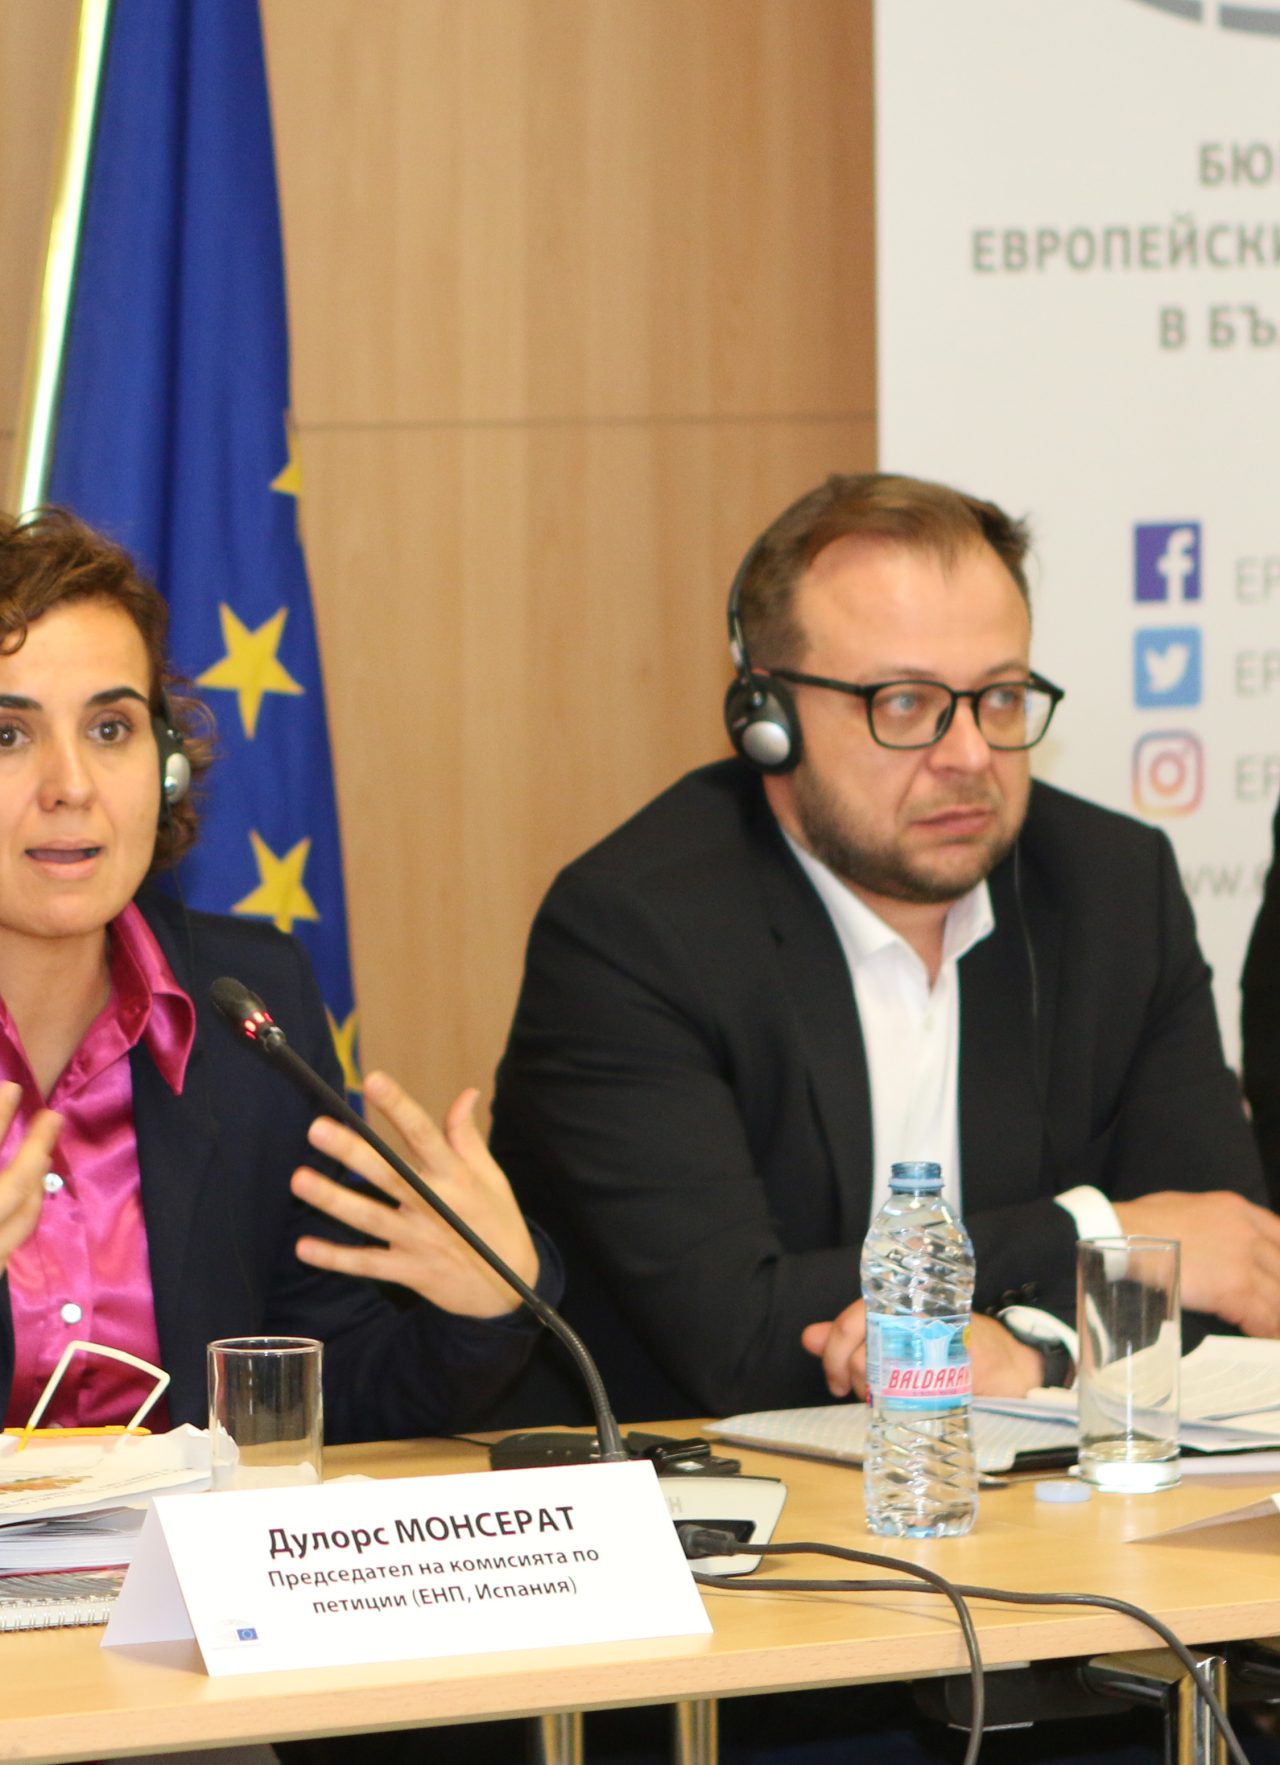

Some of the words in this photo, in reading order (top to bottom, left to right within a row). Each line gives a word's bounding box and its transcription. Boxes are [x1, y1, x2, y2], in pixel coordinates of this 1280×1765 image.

[1199, 141, 1280, 187] БЮ
[1159, 304, 1188, 351] В
[1207, 303, 1280, 350] БЪ
[1234, 556, 1280, 602] EP
[1234, 651, 1280, 697] EP
[269, 1528, 390, 1559] Дулорс
[394, 1506, 574, 1543] МОНСЕРАТ
[268, 1563, 414, 1590] Председател
[418, 1561, 445, 1575] на
[449, 1551, 568, 1573] комисията
[572, 1549, 599, 1563] по
[313, 1594, 408, 1614] петиции
[412, 1586, 472, 1608] (ЕНП,
[475, 1575, 577, 1602] Испания)
